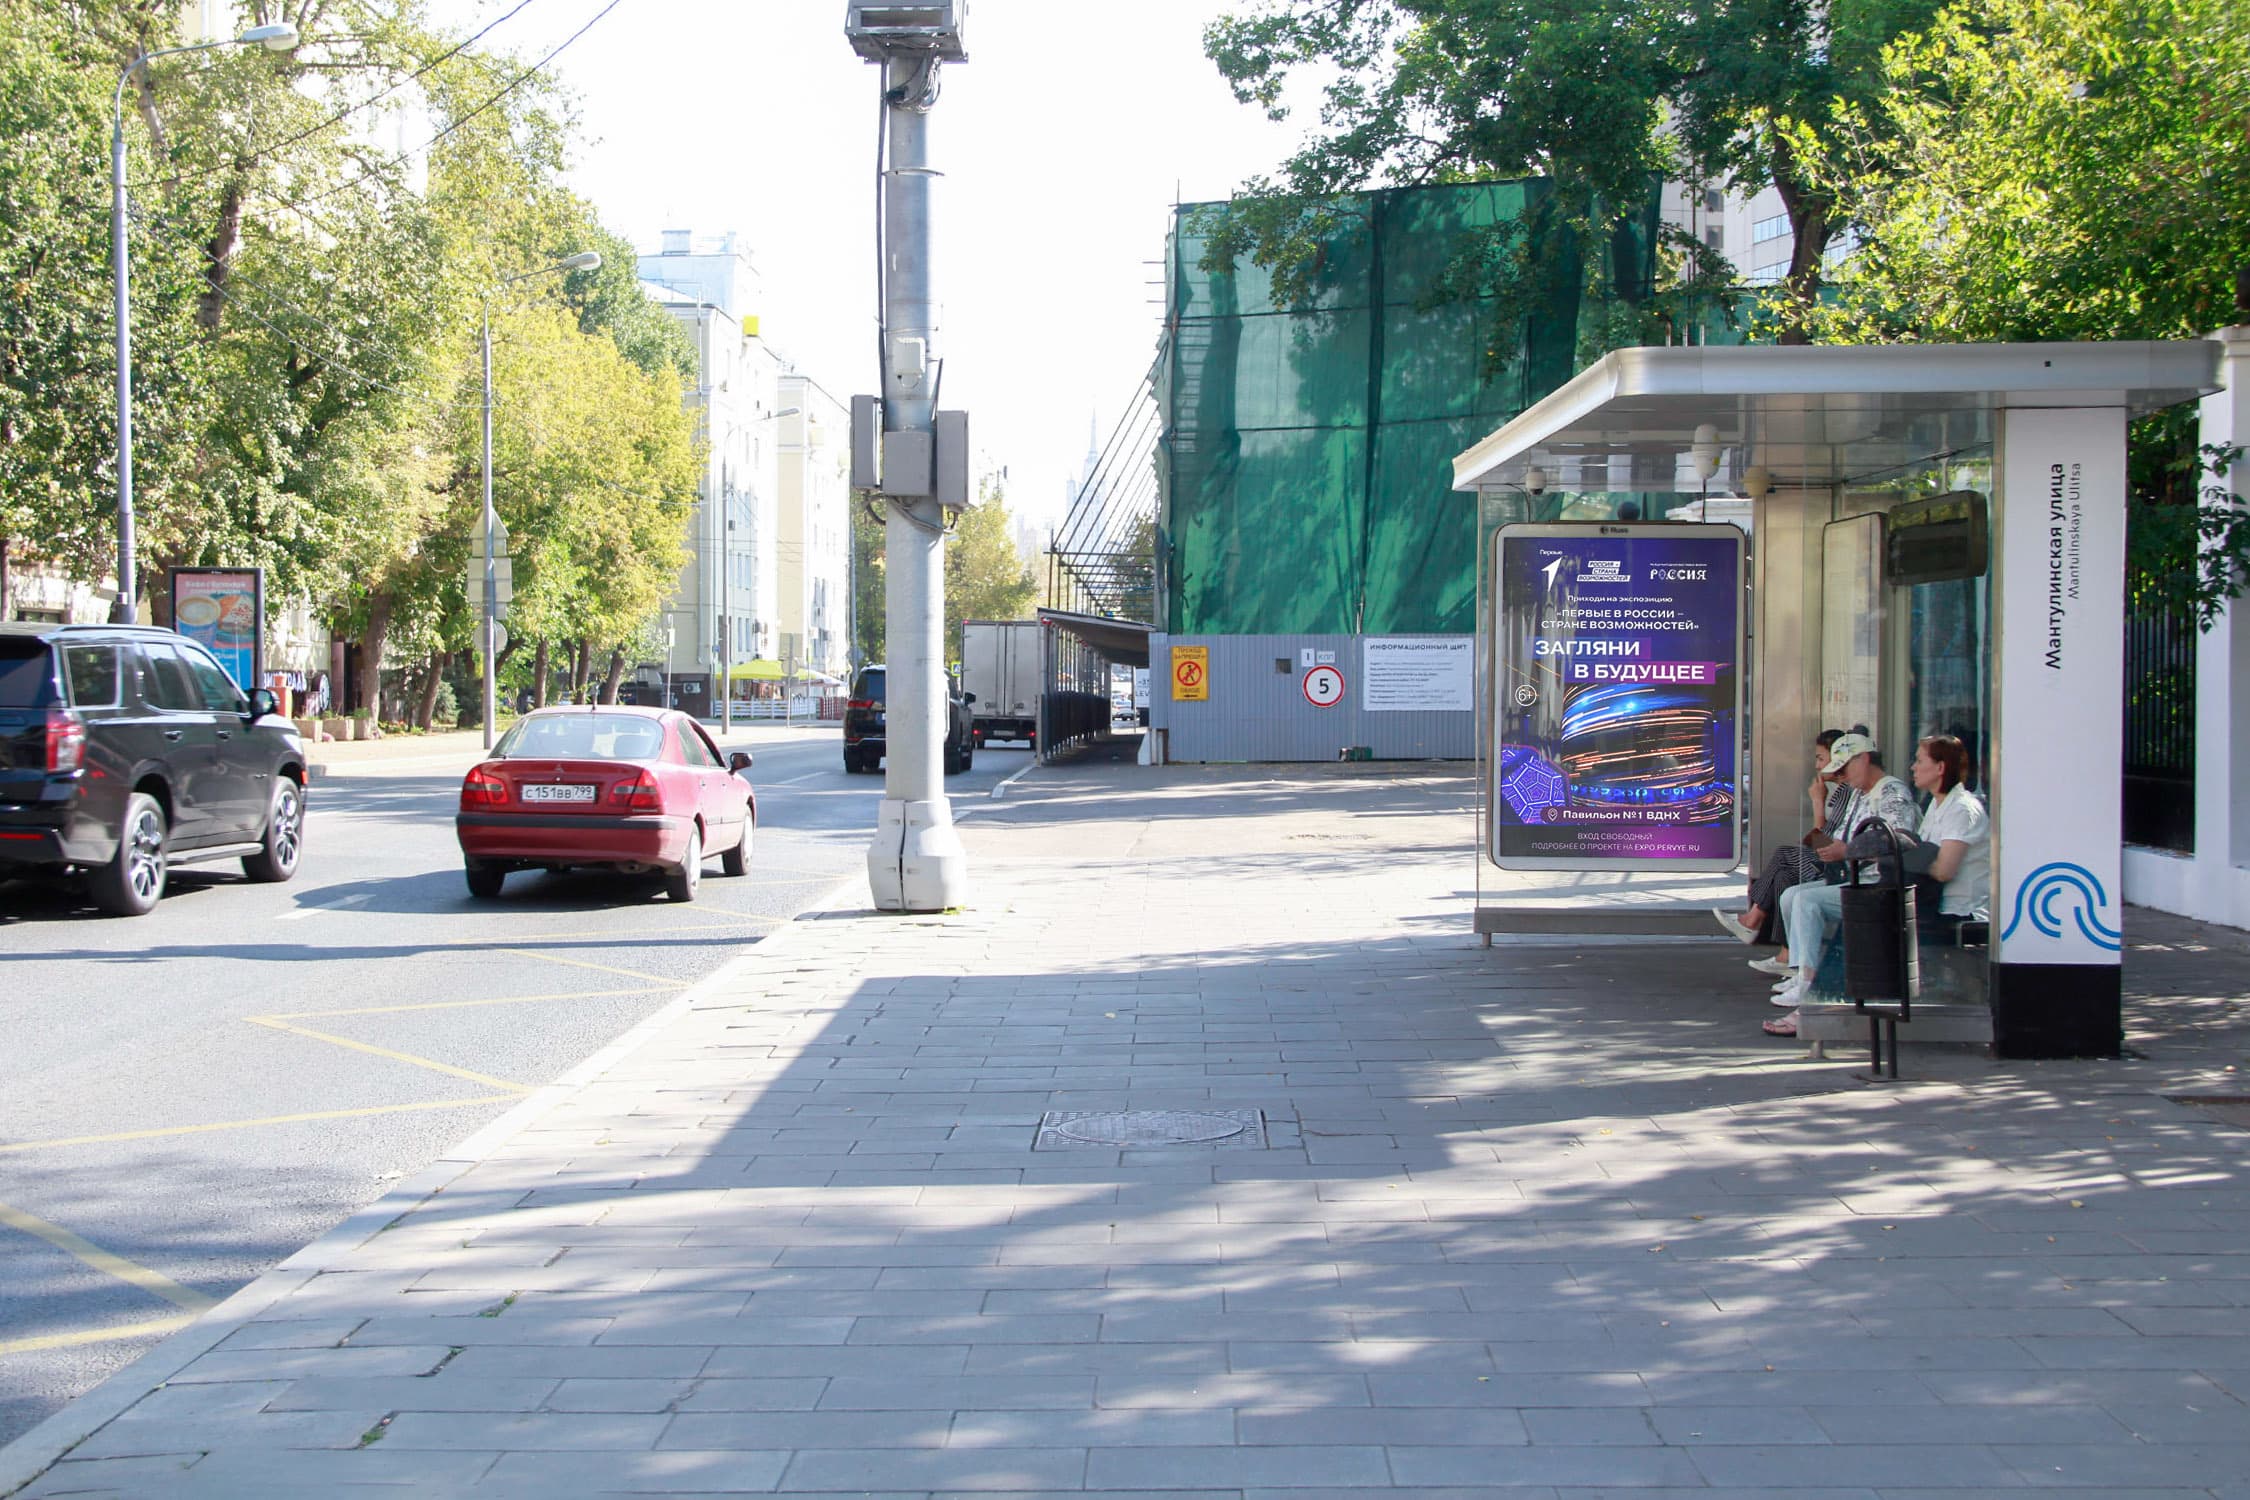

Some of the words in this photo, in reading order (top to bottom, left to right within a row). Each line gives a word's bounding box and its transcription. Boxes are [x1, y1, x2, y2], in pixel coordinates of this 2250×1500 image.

[2068, 463, 2082, 501] Ulitsa
[2050, 463, 2066, 521] улица
[2068, 504, 2083, 600] Mantulinskaya
[1650, 569, 1707, 580] РОССИЯ
[1567, 595, 1605, 603] Приходи
[2045, 527, 2065, 669] Мантулинская
[1613, 609, 1622, 618] В
[1624, 610, 1675, 619] РОССИИ
[1541, 620, 1588, 629] СТРАНЕ
[1535, 640, 1640, 656] ЗАГЛЯНИ
[1574, 664, 1589, 679] В
[1594, 664, 1705, 682] БУДУЩЕЕ
[1319, 678, 1330, 694] 5
[1518, 688, 1533, 702] 6+
[1562, 810, 1621, 820] Павильон
[1622, 811, 1643, 820] №1
[1646, 811, 1681, 821] ВДНХ
[1577, 832, 1600, 841] ВХОД
[1531, 842, 1578, 850] ПОДРОБНЕЕ
[1587, 843, 1622, 851] ПРОЕКТЕ
[1623, 843, 1634, 851] НА
